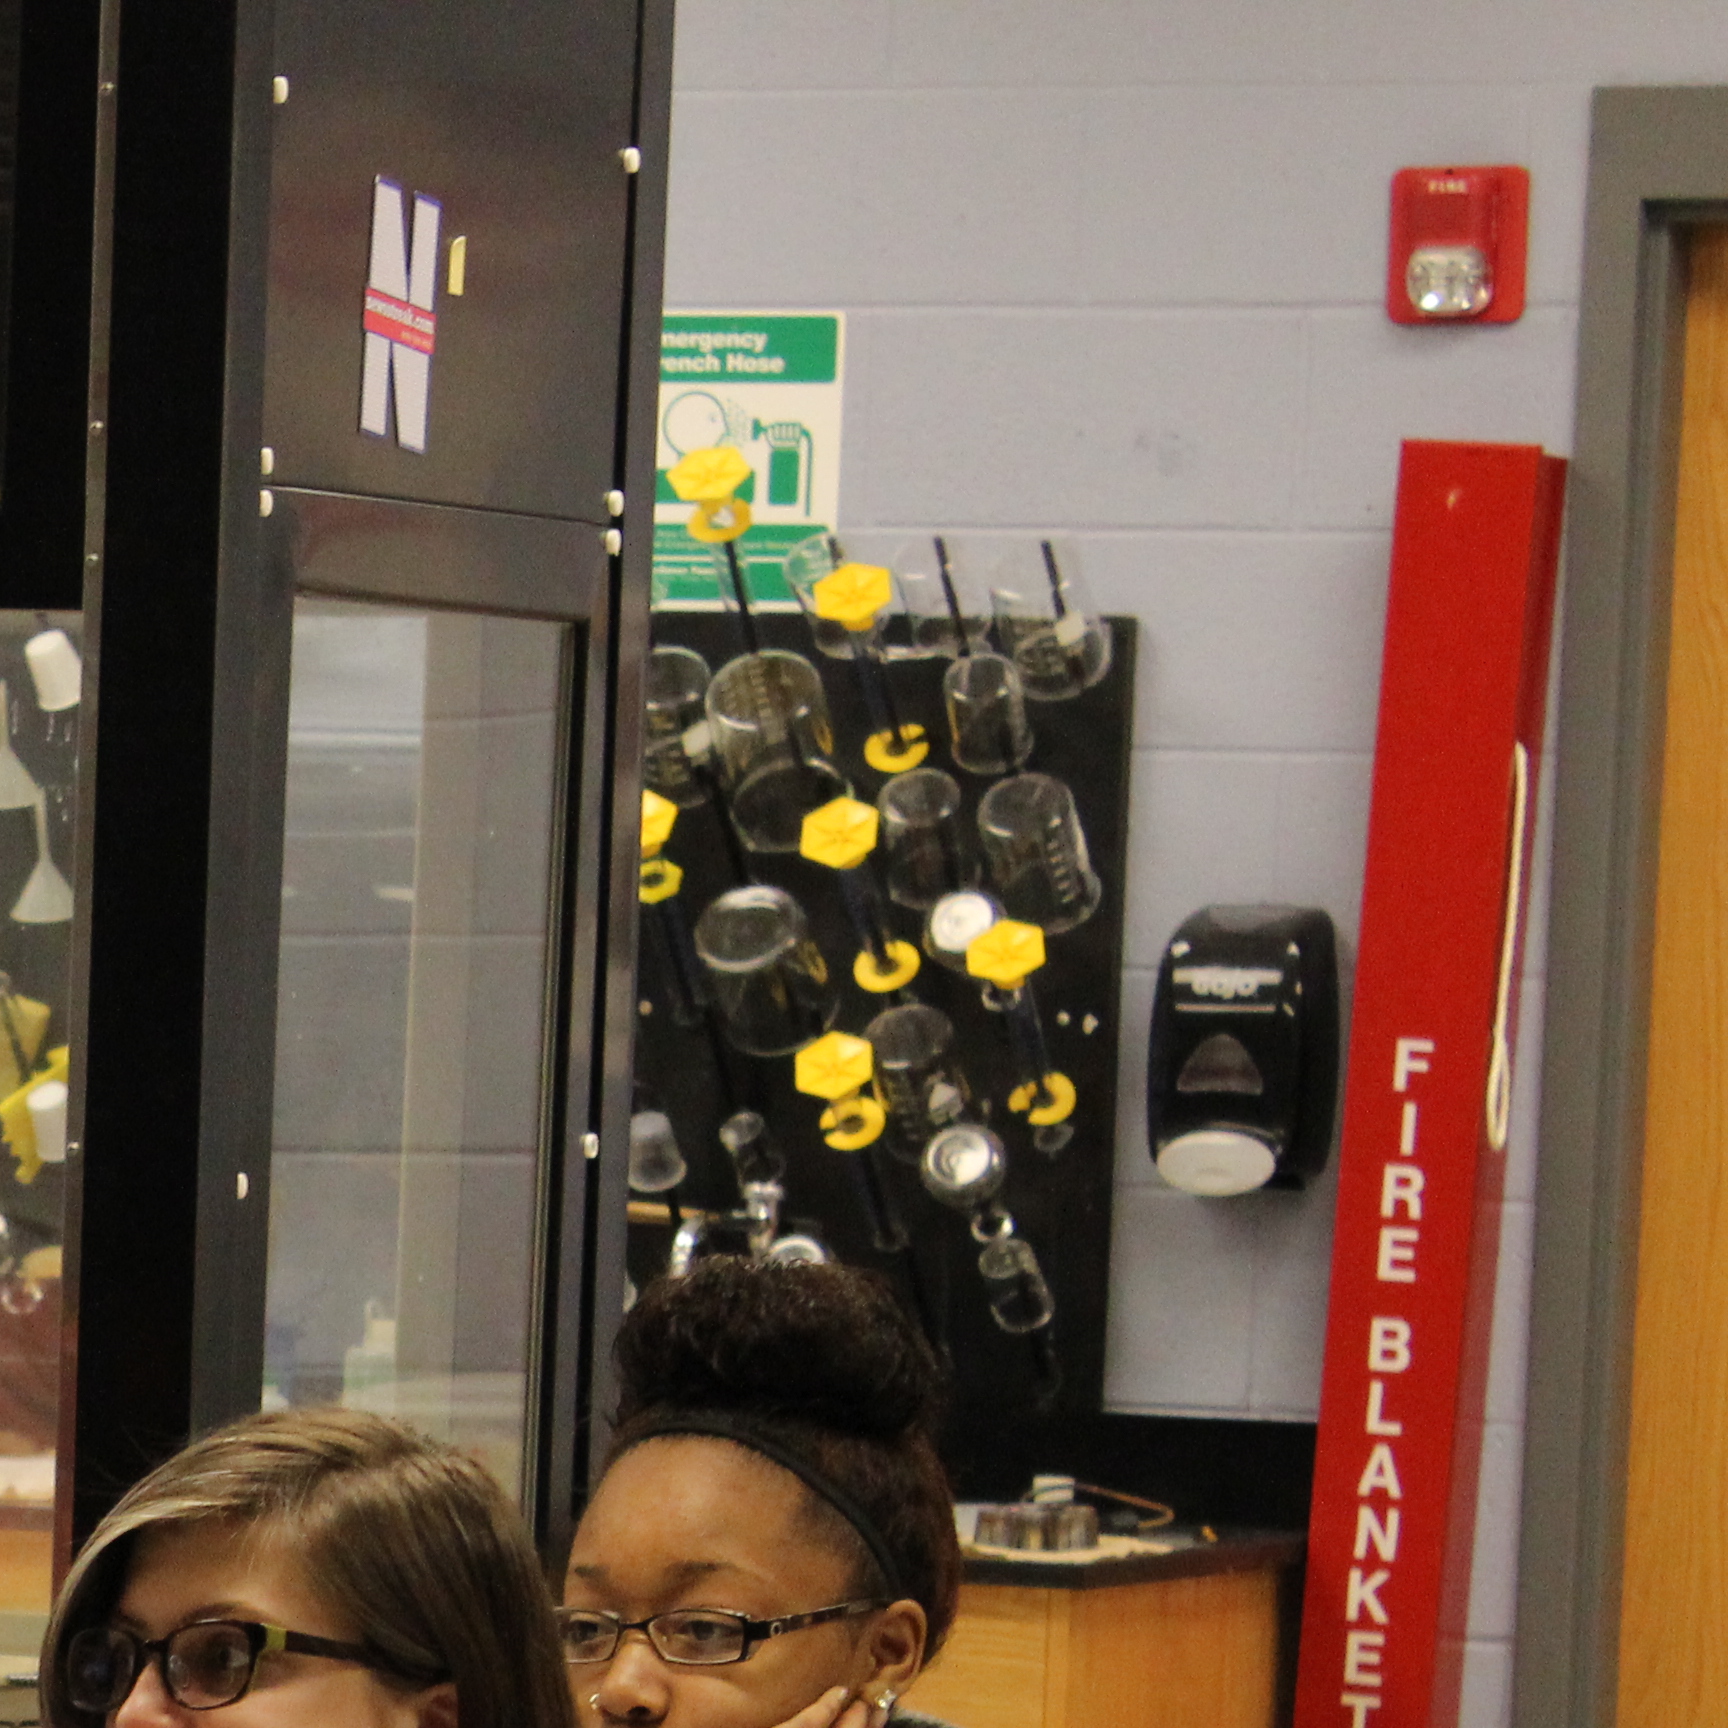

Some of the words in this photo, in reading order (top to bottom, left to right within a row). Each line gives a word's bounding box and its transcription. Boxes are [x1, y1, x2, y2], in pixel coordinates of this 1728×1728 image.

[661, 331, 768, 353] mergency
[725, 352, 786, 374] Hose
[1375, 1037, 1434, 1284] FIRE
